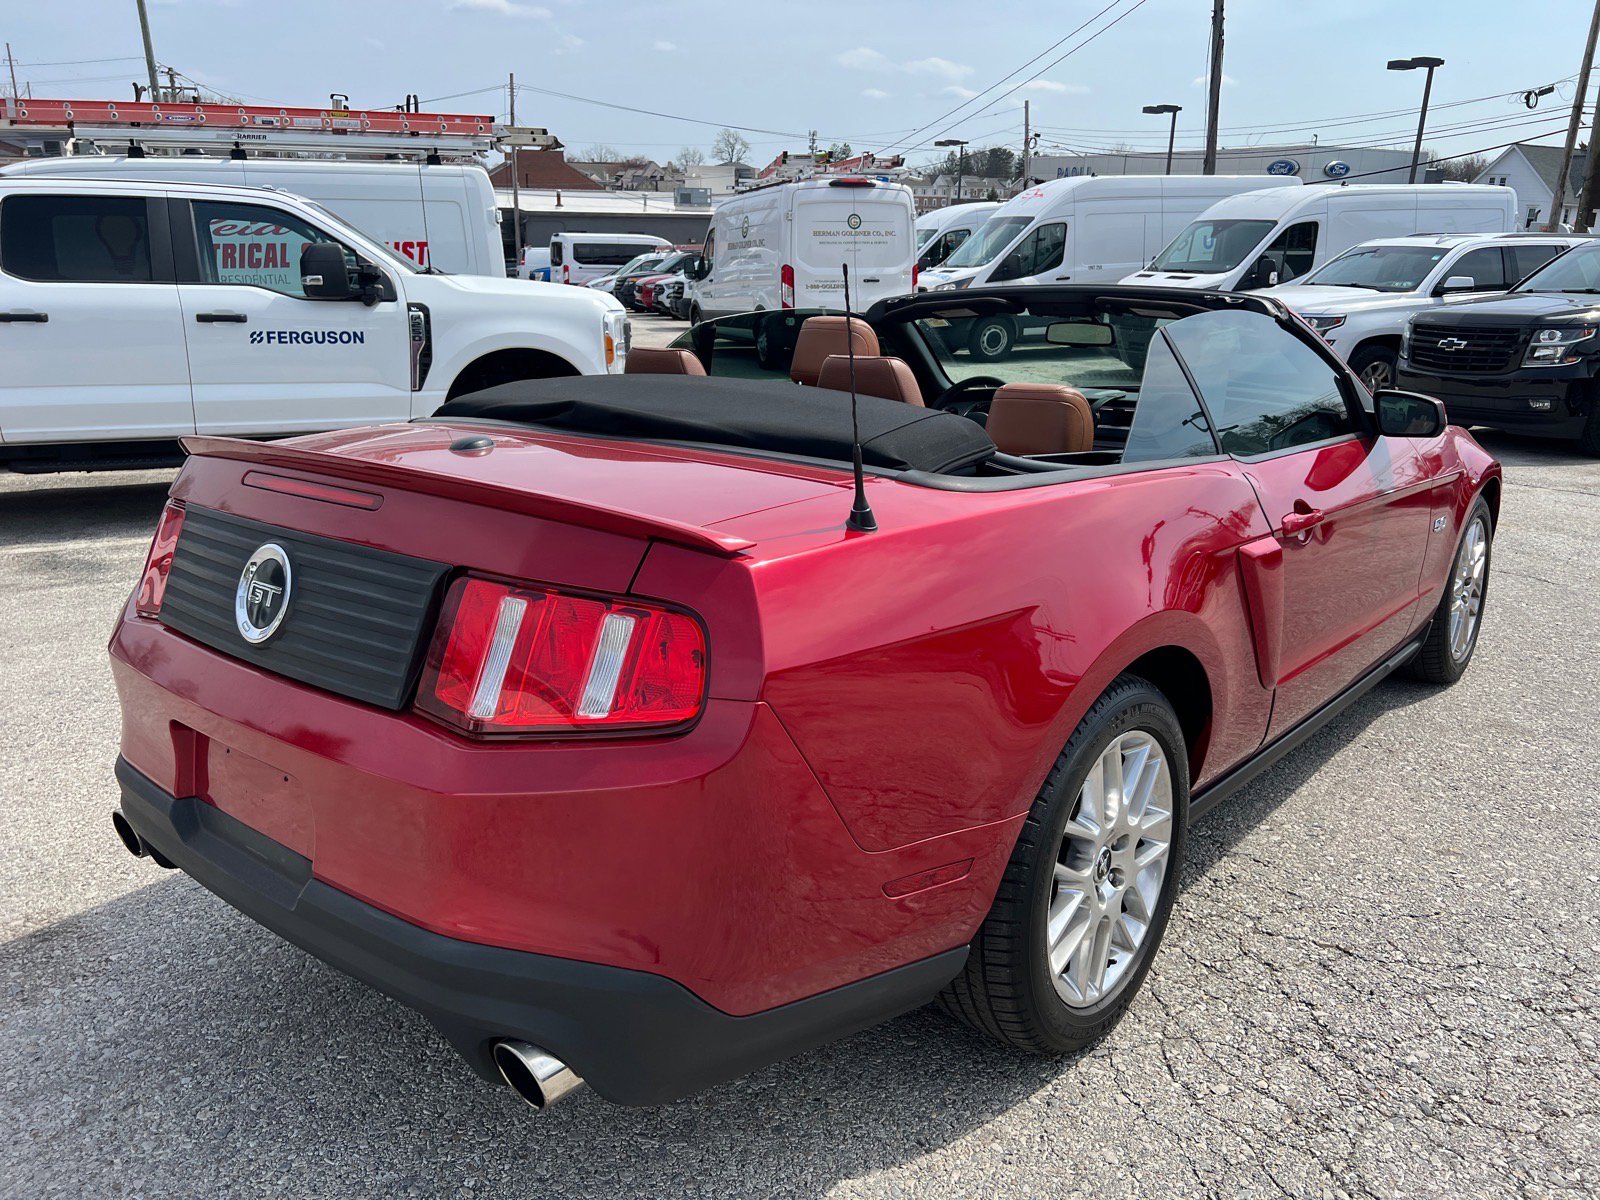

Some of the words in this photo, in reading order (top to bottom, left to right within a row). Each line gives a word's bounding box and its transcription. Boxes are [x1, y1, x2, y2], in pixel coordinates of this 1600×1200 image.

[220, 274, 291, 285] RESIDENTIAL
[266, 331, 364, 344] FERGUSON
[248, 580, 282, 608] GT
